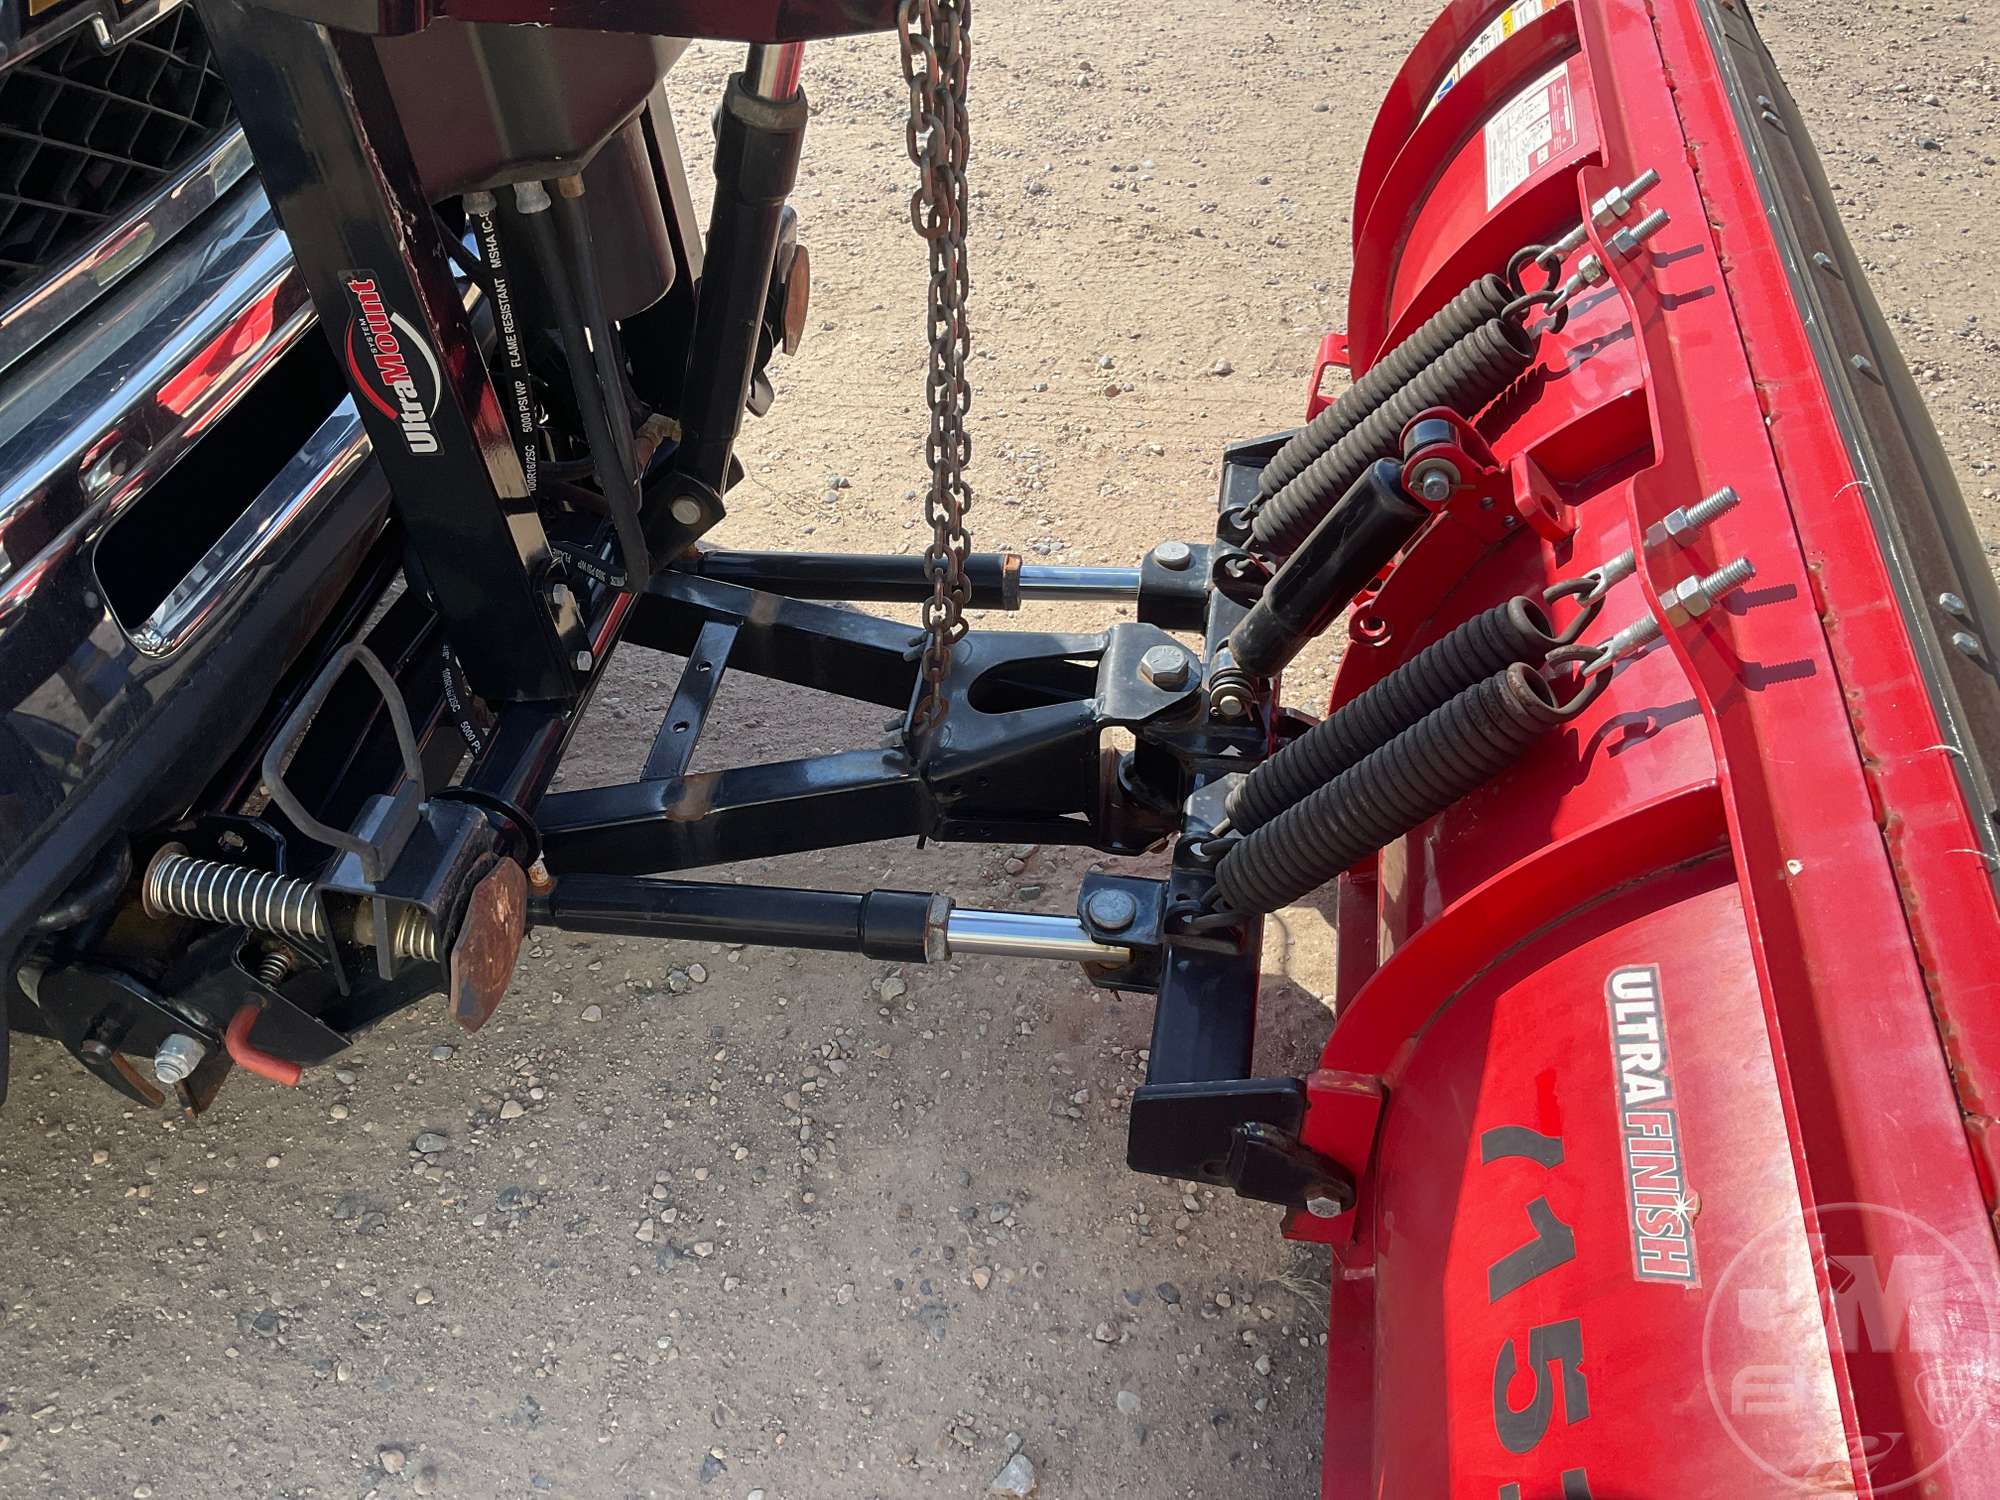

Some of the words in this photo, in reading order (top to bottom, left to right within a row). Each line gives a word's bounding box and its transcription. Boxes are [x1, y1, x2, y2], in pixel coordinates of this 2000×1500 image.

[487, 233, 502, 268] MSHA
[494, 278, 515, 333] RESISTANT
[358, 318, 378, 353] SYSTEM
[505, 334, 522, 367] FLAME
[515, 380, 527, 396] WP
[518, 396, 530, 411] PSI
[520, 412, 533, 433] 5000
[460, 720, 476, 741] 5000
[1611, 970, 1666, 1104] ULTRA
[1625, 1111, 1691, 1278] FINISH
